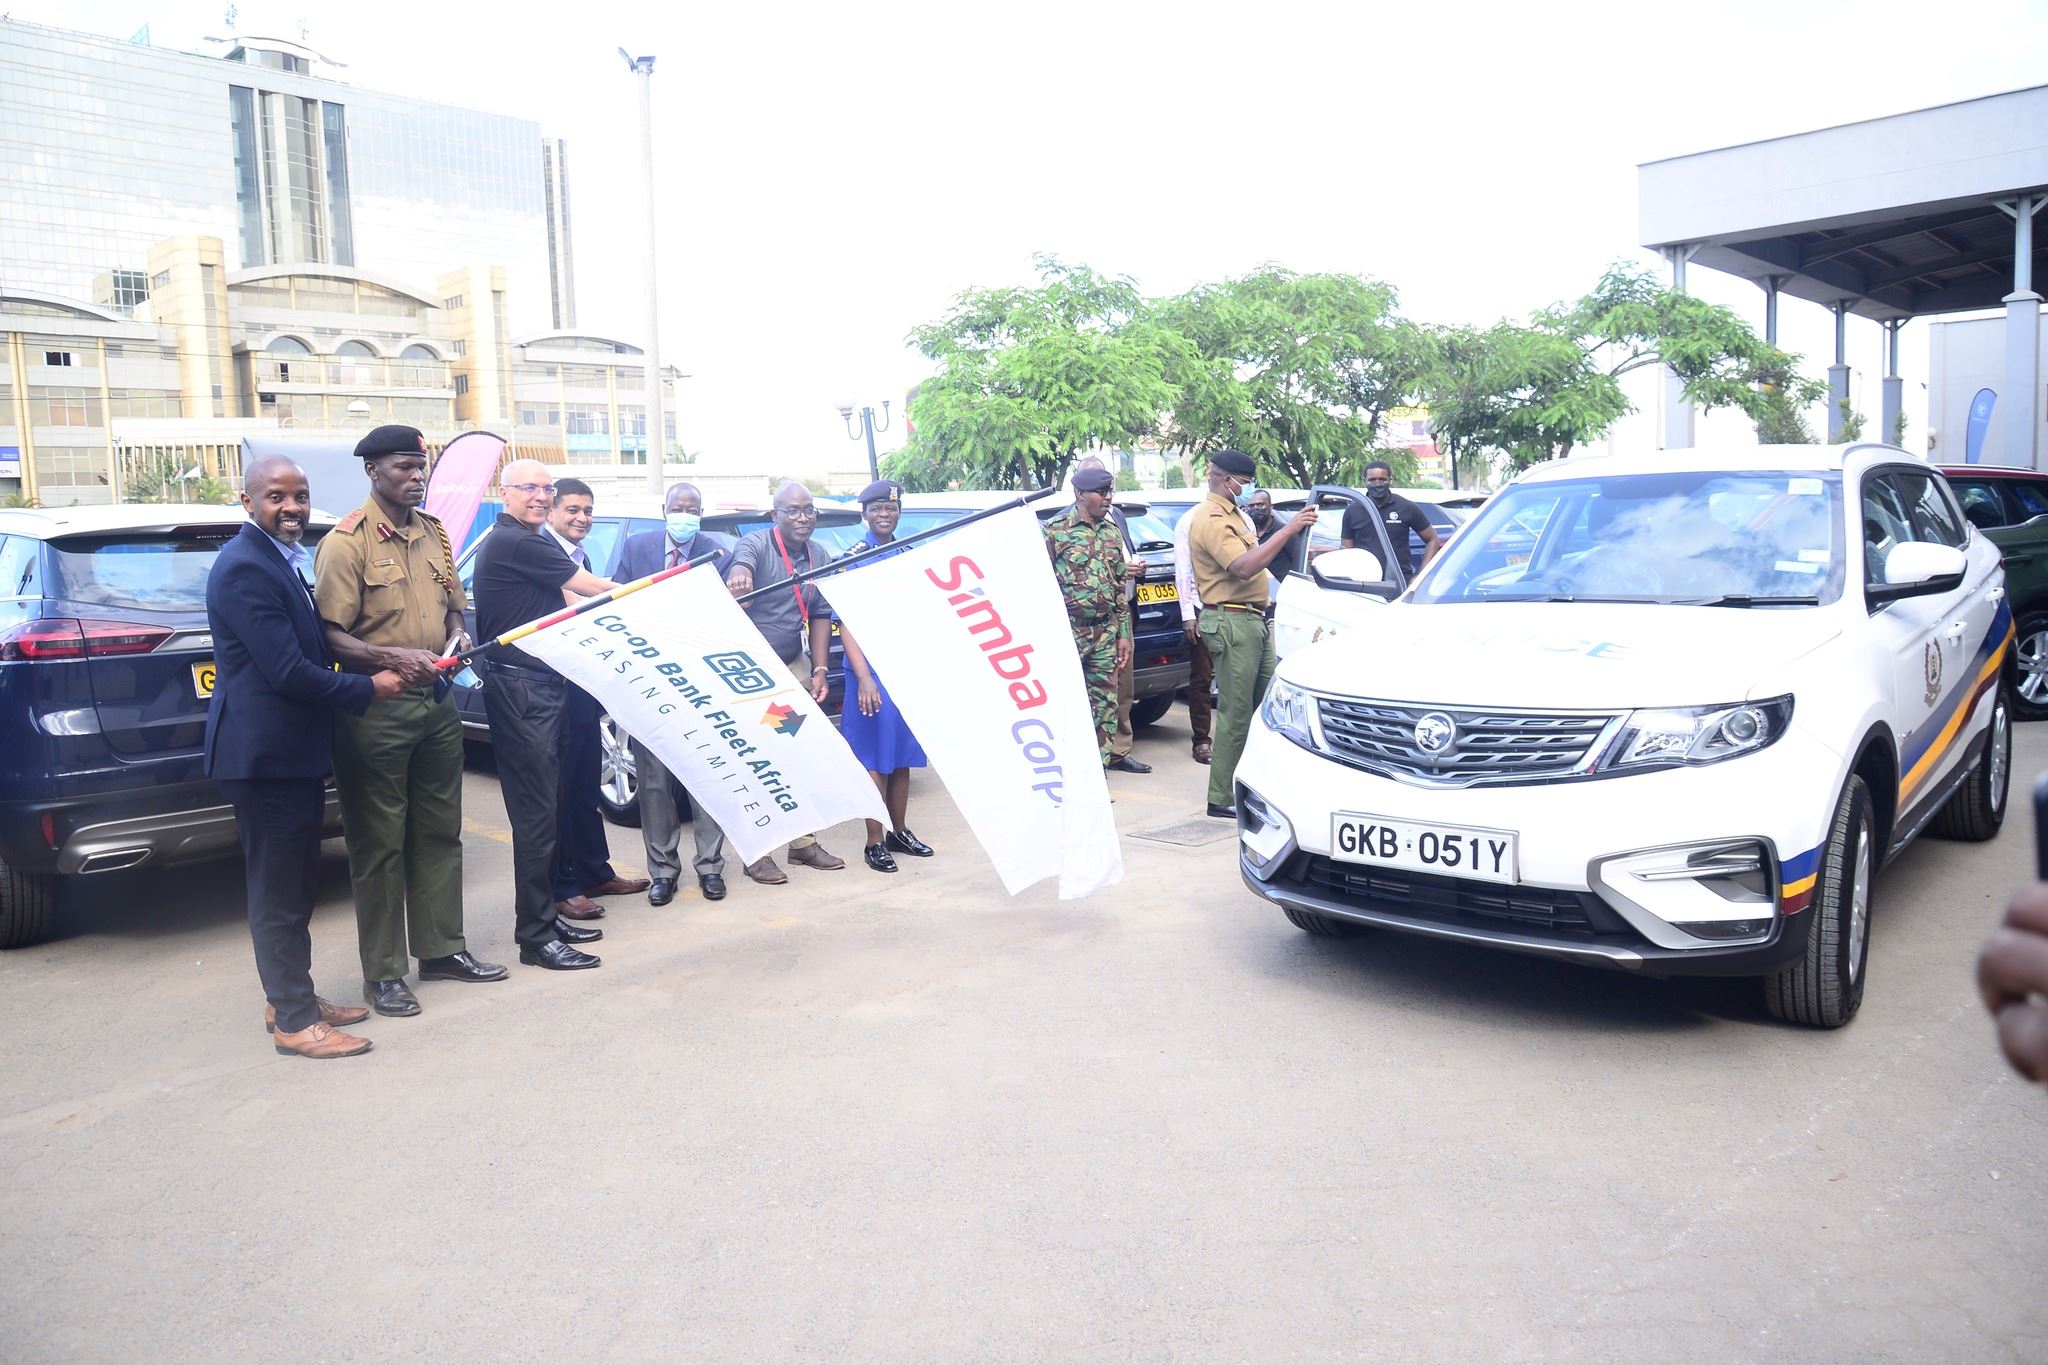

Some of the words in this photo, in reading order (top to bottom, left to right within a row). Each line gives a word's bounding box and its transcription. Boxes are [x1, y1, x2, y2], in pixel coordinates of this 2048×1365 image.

[593, 615, 661, 659] Co-op
[655, 662, 713, 709] Bank
[703, 710, 757, 758] Fleet
[745, 759, 799, 813] Africa
[924, 555, 1048, 711] Simba
[560, 627, 677, 715] LEASING
[683, 729, 771, 828] LIMITED
[1338, 822, 1399, 858] GKB
[1418, 831, 1508, 874] 051Y
